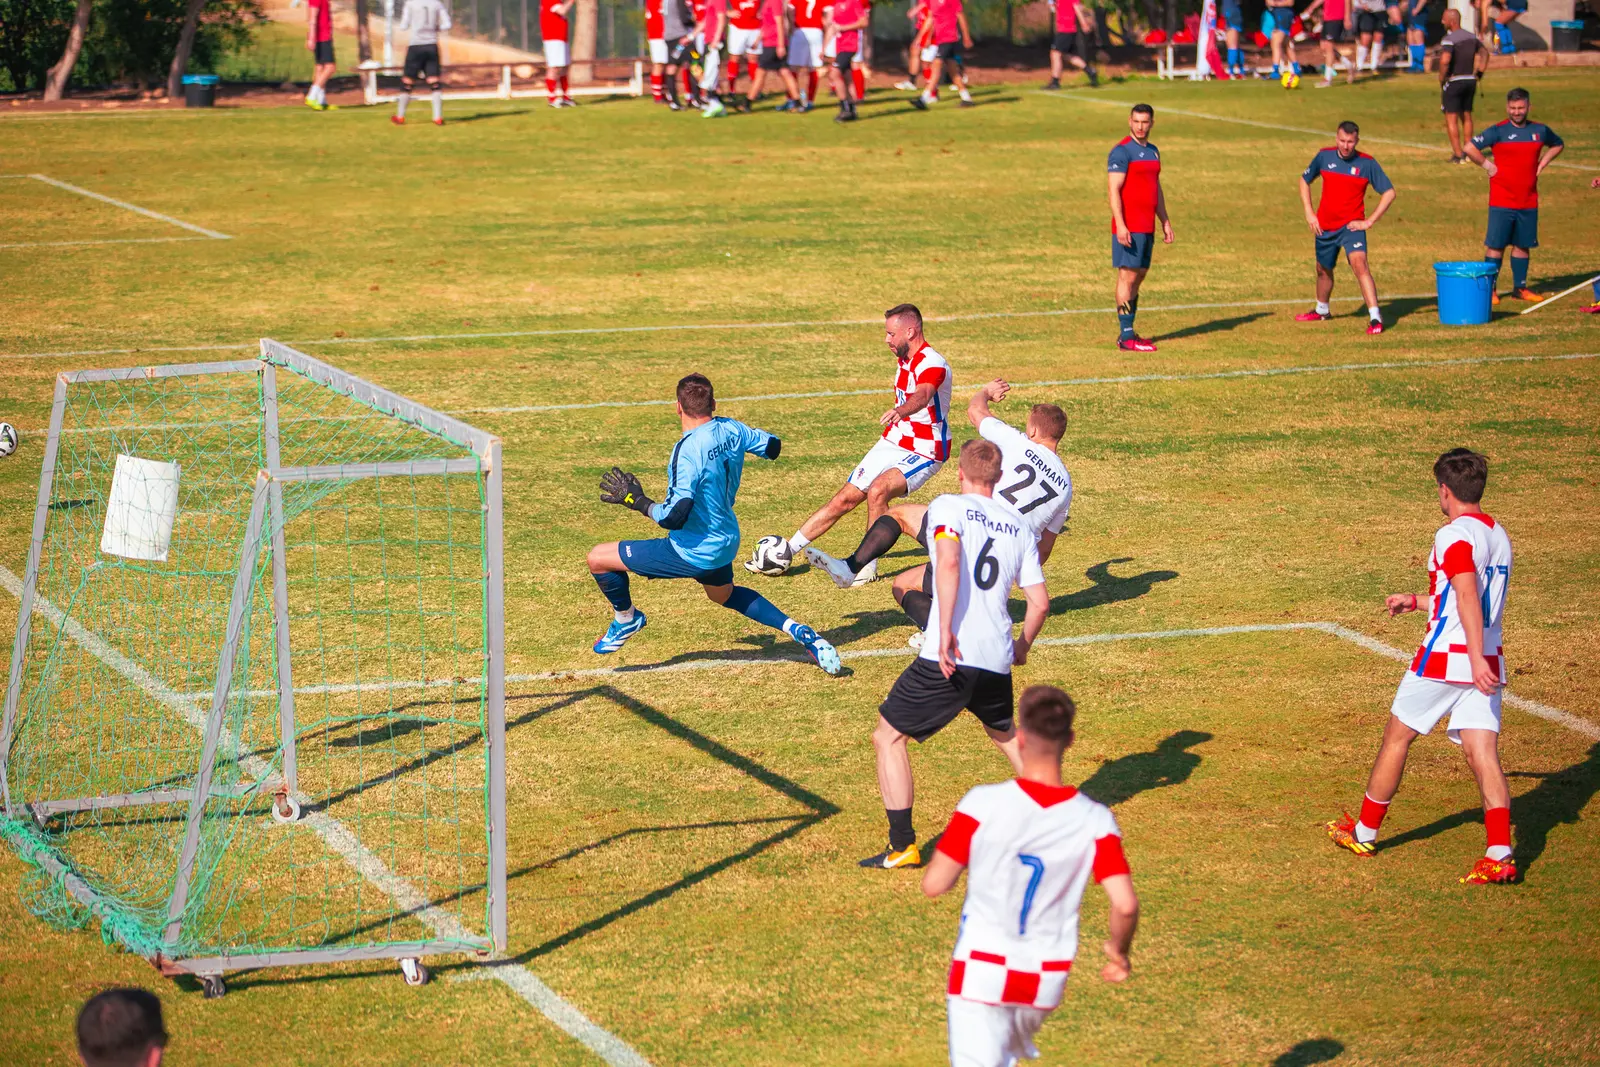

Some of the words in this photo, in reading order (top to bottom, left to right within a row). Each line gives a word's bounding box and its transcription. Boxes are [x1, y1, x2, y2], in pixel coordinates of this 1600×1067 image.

[998, 463, 1059, 515] 27
[1025, 449, 1068, 490] GERMANY
[966, 509, 1020, 537] GERMANY
[974, 536, 999, 591] 6
[1481, 565, 1508, 628] 17
[1018, 852, 1044, 935] 7
